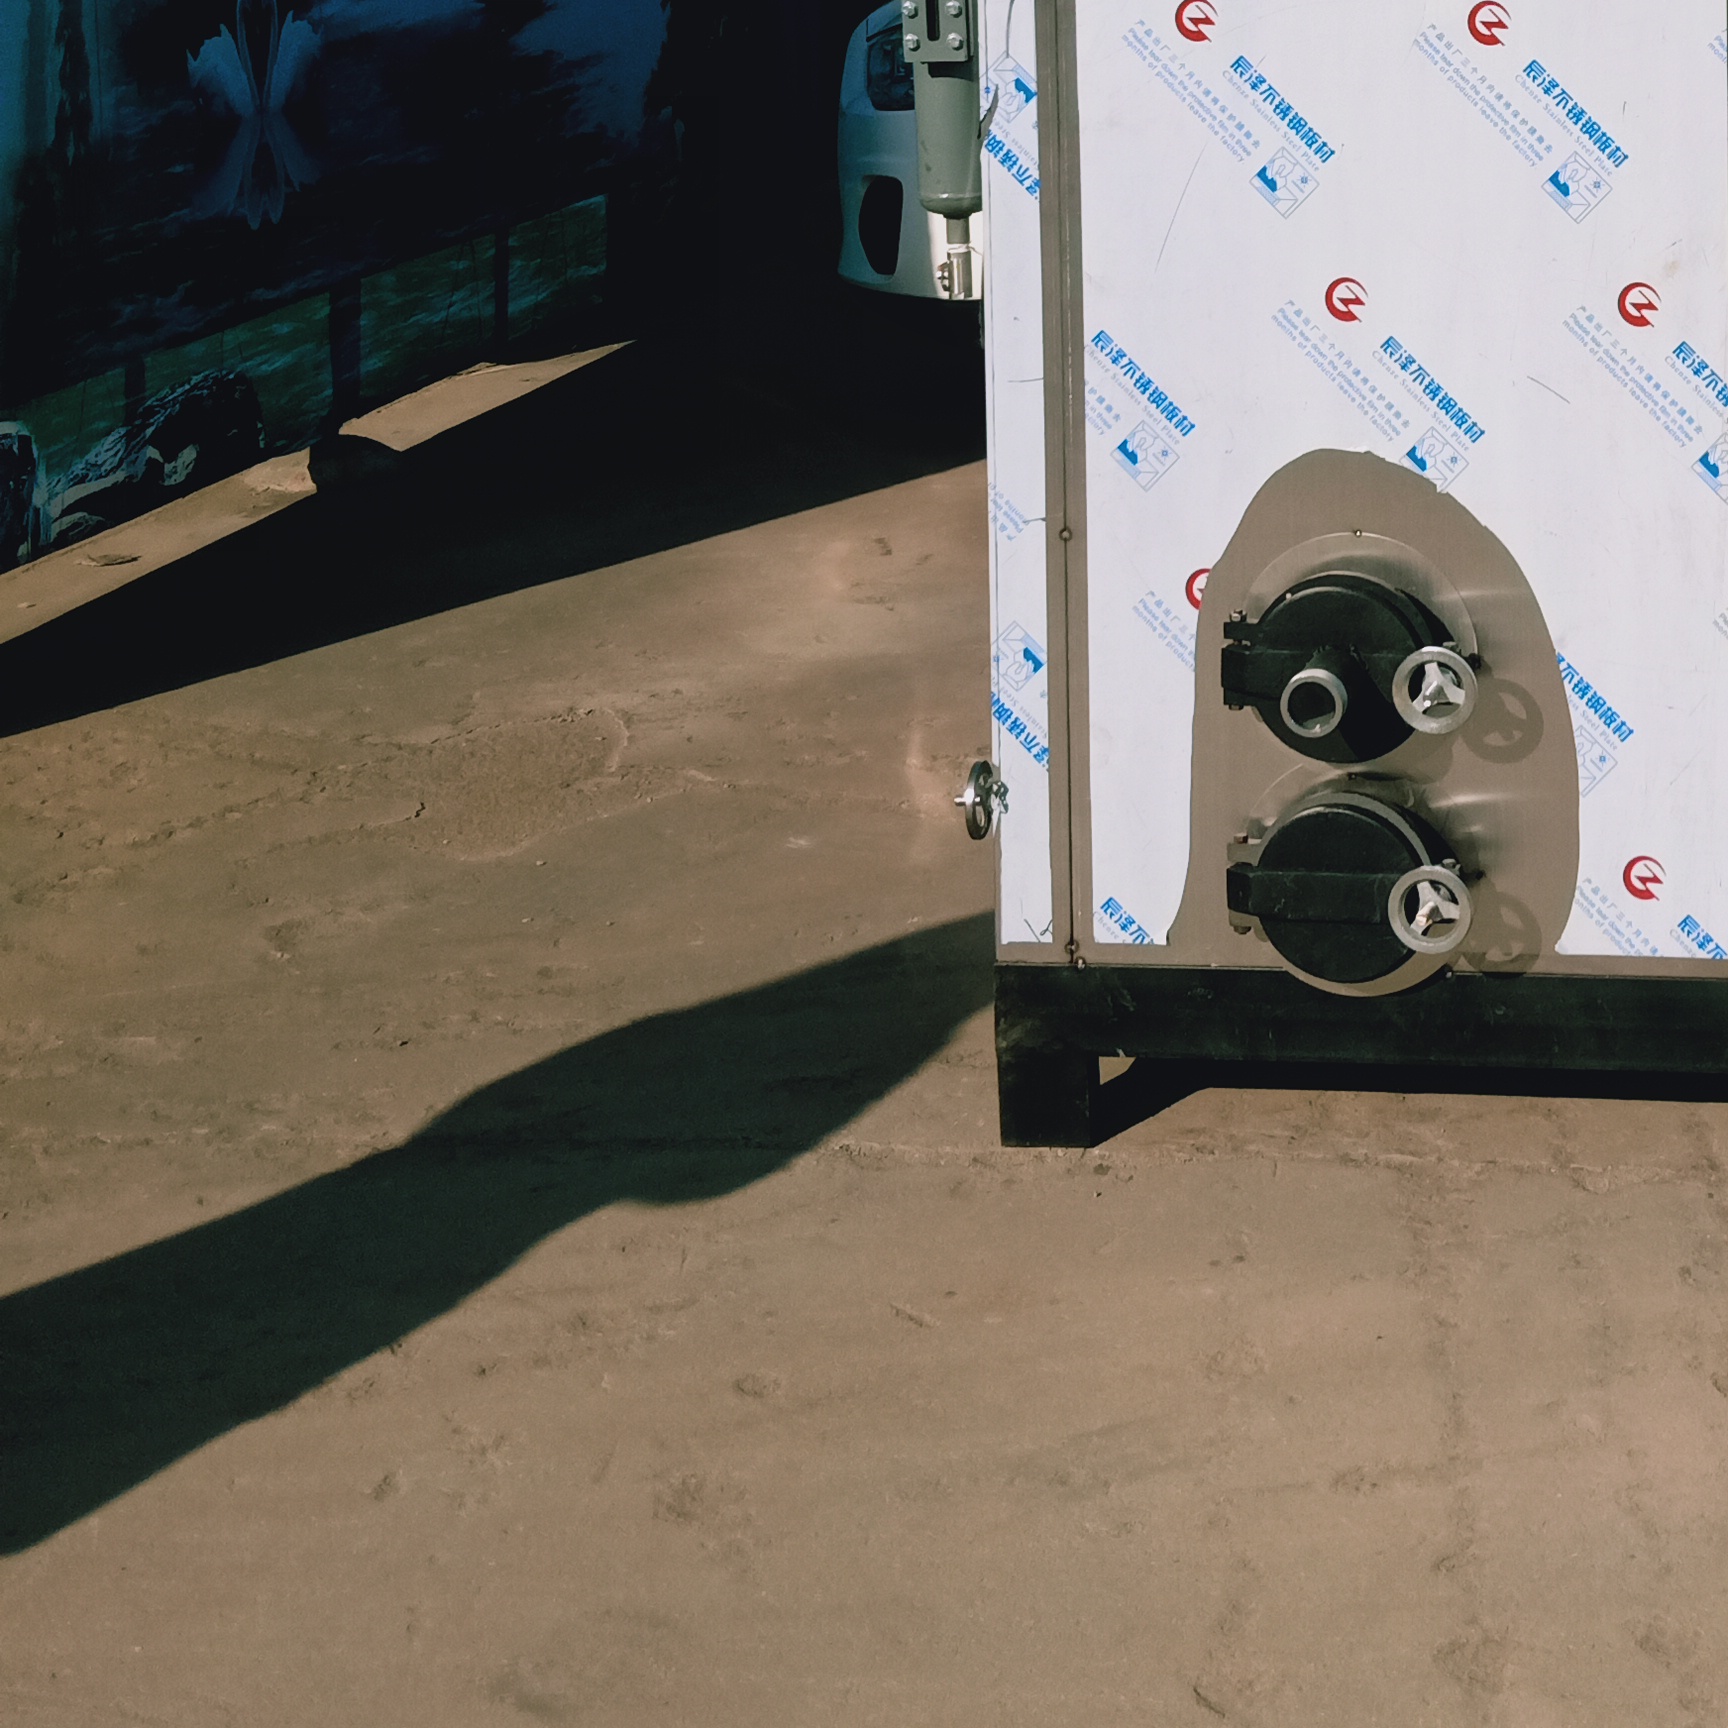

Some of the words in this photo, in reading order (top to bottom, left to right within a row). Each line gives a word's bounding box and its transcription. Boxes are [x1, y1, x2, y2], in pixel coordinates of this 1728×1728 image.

[1229, 55, 1335, 163] 辰泽不锈钢板材
[1522, 59, 1629, 168] 辰泽不锈钢板材
[1090, 329, 1195, 436] 辰泽不锈钢板材
[1379, 335, 1485, 443] 辰泽不锈钢板材
